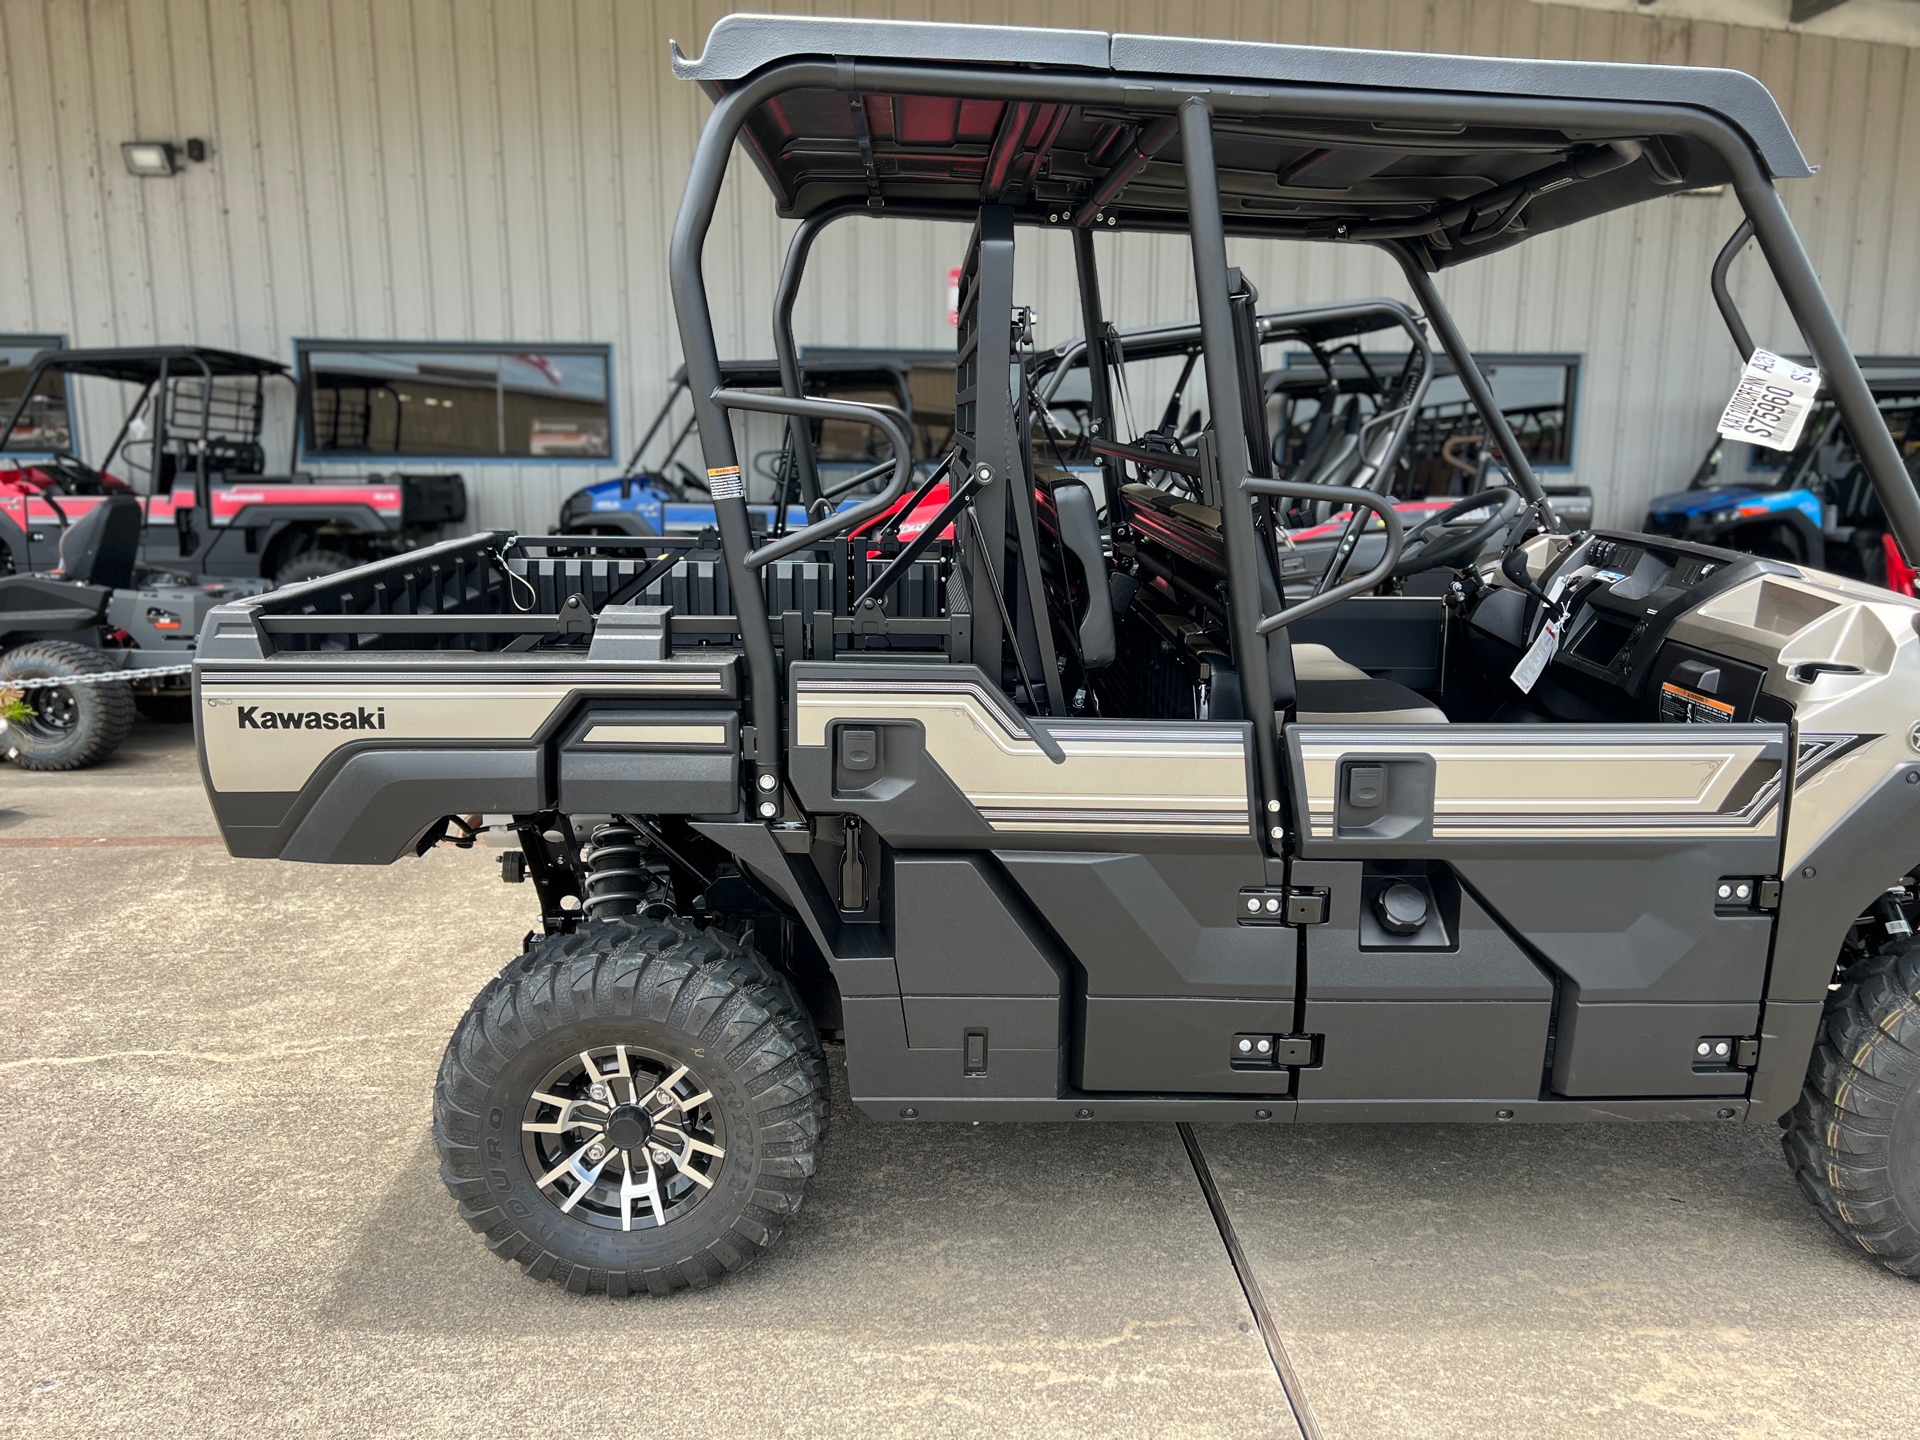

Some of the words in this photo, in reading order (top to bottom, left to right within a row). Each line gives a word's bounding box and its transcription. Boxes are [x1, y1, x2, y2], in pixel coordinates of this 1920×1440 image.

[1743, 385, 1795, 438] S75960
[237, 706, 386, 730] Kawasaki
[485, 1105, 534, 1220] DURO
[708, 1066, 754, 1193] FRONTIER
